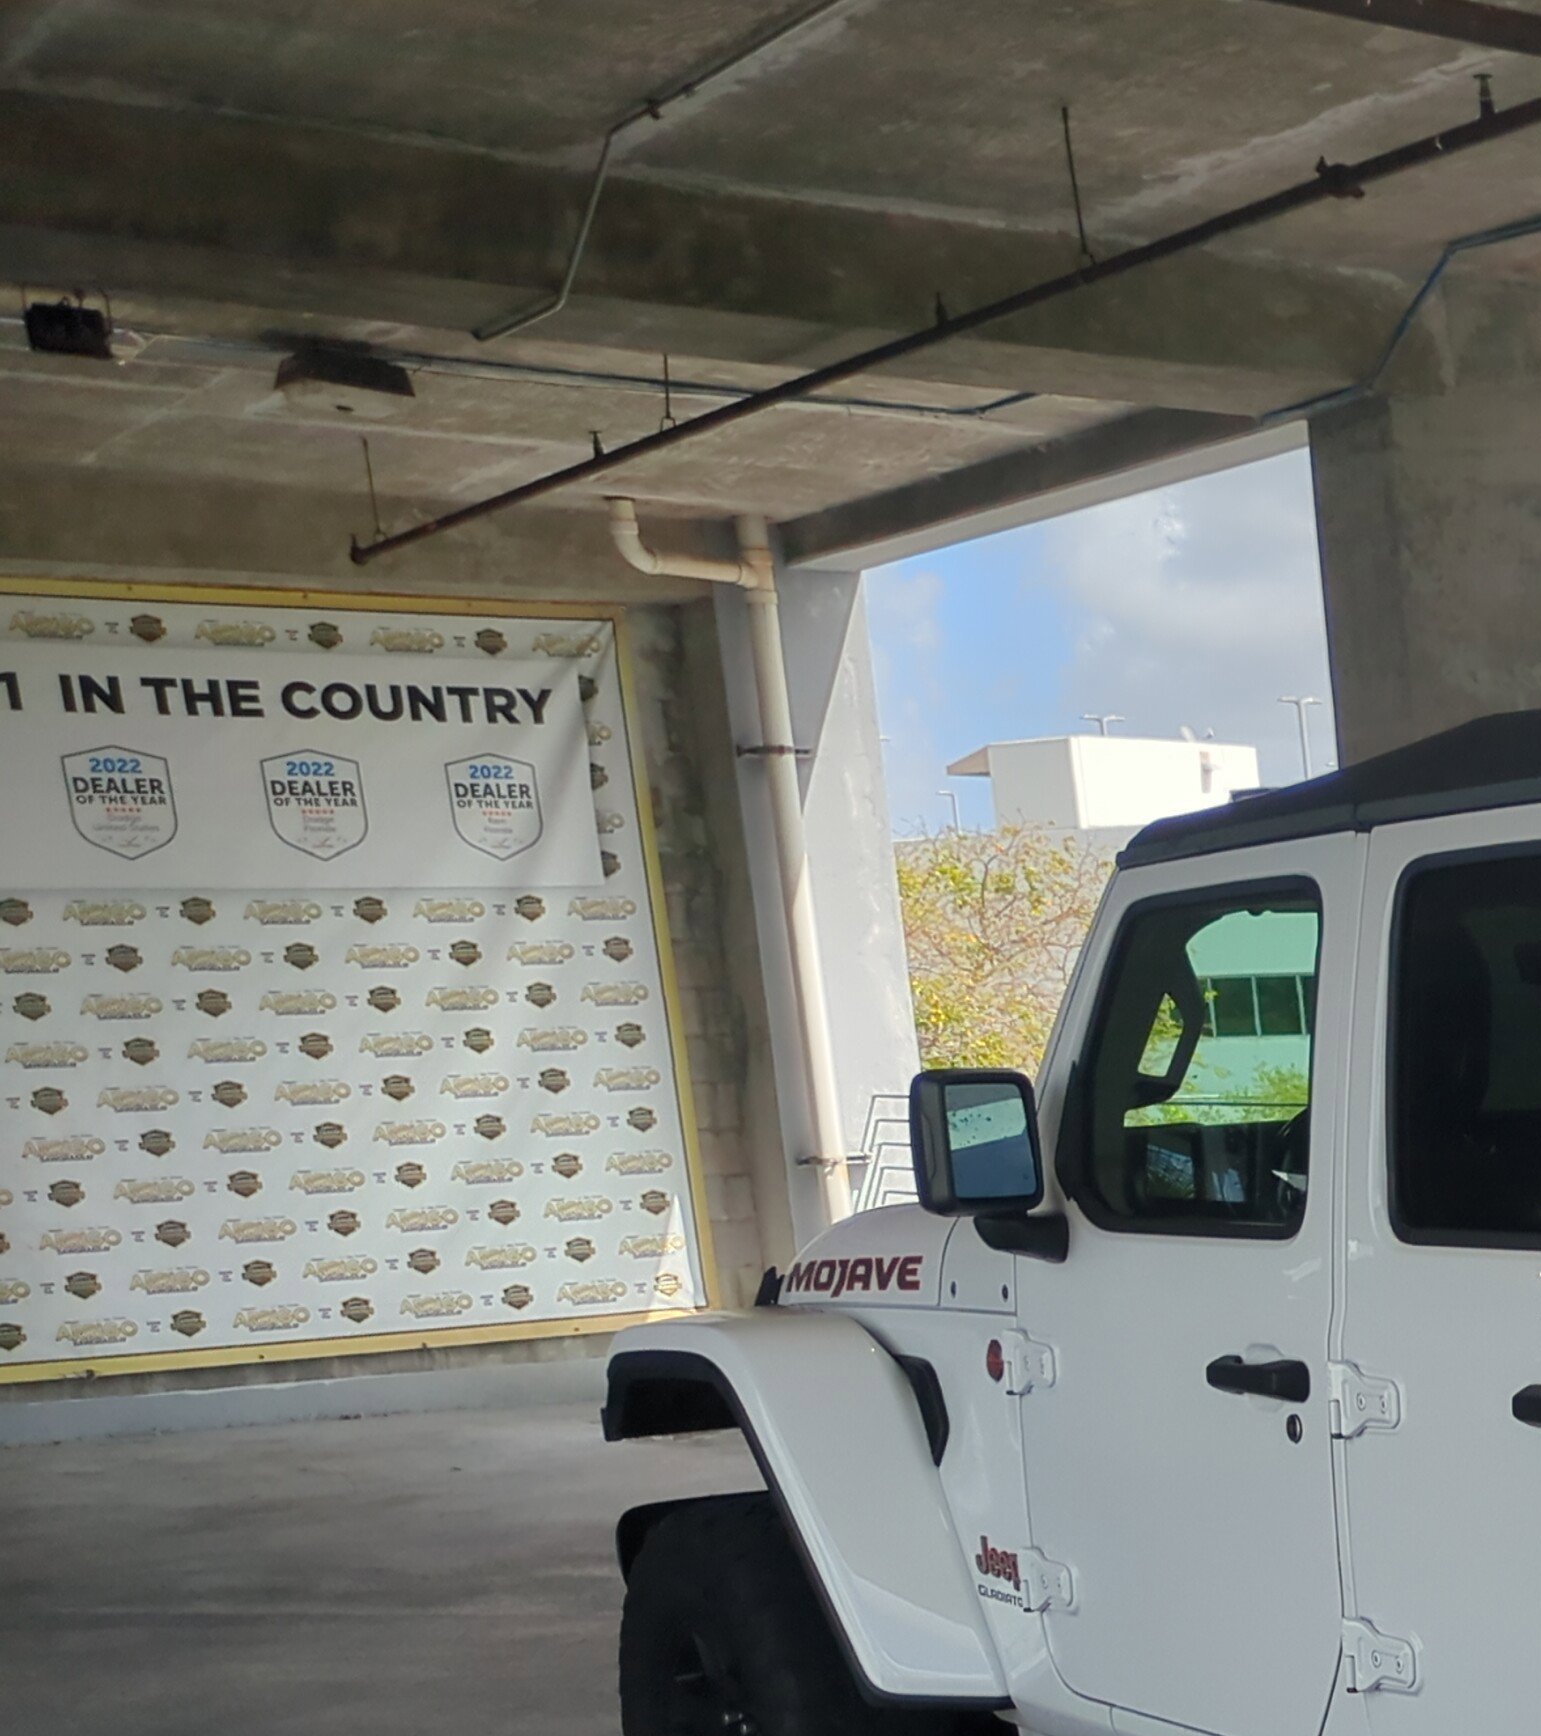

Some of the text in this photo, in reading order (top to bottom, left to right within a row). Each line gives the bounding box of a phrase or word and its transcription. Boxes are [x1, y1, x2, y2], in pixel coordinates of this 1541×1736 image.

[58, 673, 125, 714] IN
[140, 677, 265, 717] THE
[281, 680, 552, 724] COUNTRY
[88, 758, 143, 774] 2022
[286, 761, 335, 777] 2022
[469, 765, 514, 780] 2022
[72, 776, 165, 795] DEALER
[270, 780, 357, 797] DEALER
[454, 783, 532, 799] DEALER
[76, 795, 167, 806] OF THE YEAR
[273, 797, 359, 808] OF THE YEAR
[457, 799, 534, 810] OF THE YEAR
[785, 1254, 924, 1298] MOJAVE
